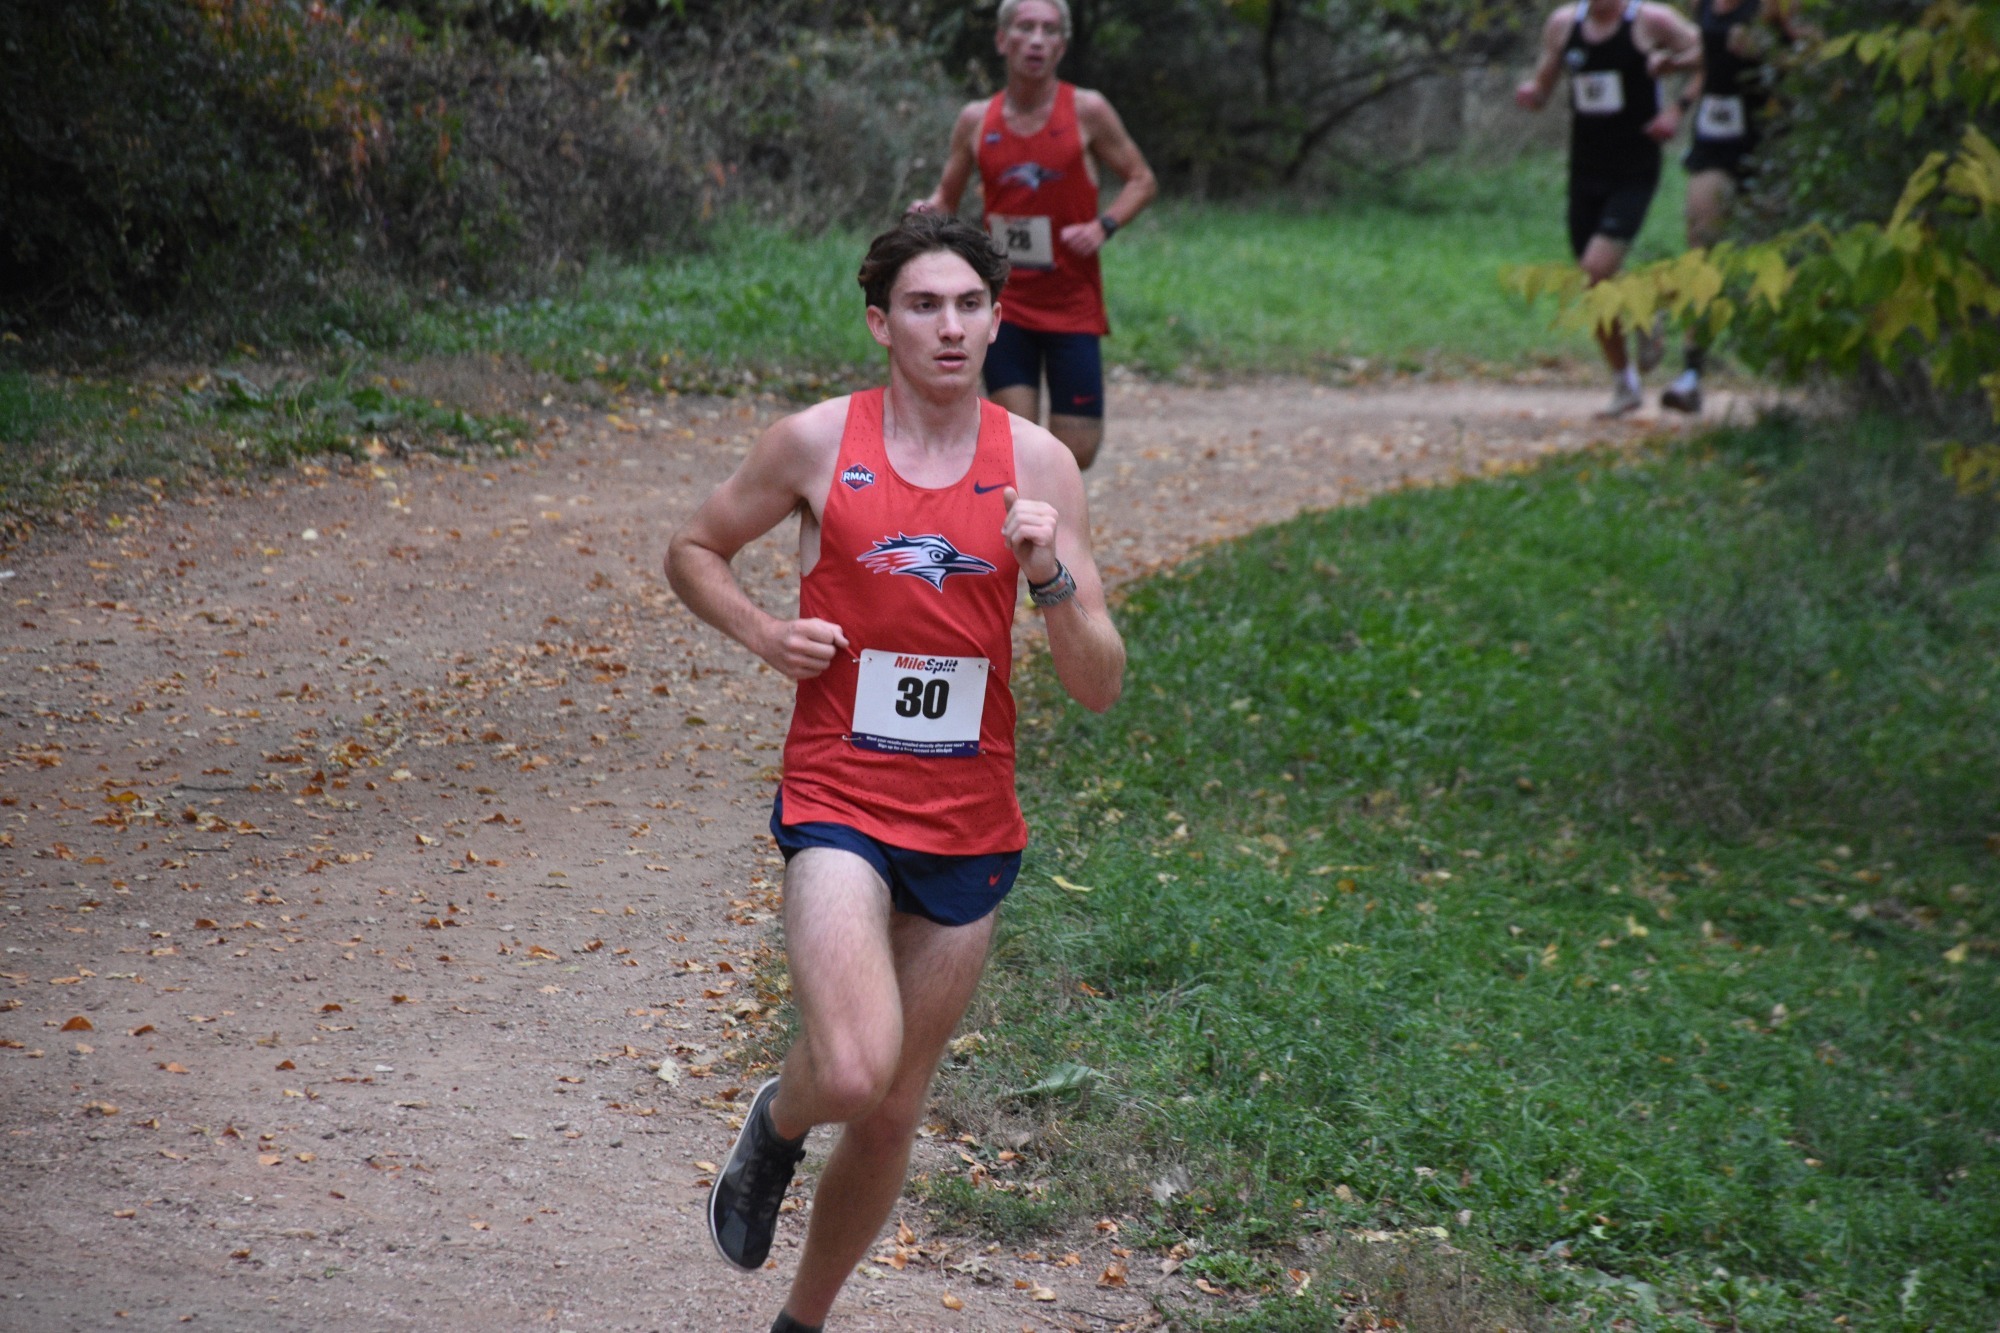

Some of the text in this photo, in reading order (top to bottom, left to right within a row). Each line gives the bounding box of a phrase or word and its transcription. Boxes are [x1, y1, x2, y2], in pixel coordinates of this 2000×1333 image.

[843, 471, 873, 483] RMAC
[894, 656, 958, 674] MileSplit
[895, 676, 950, 720] 30
